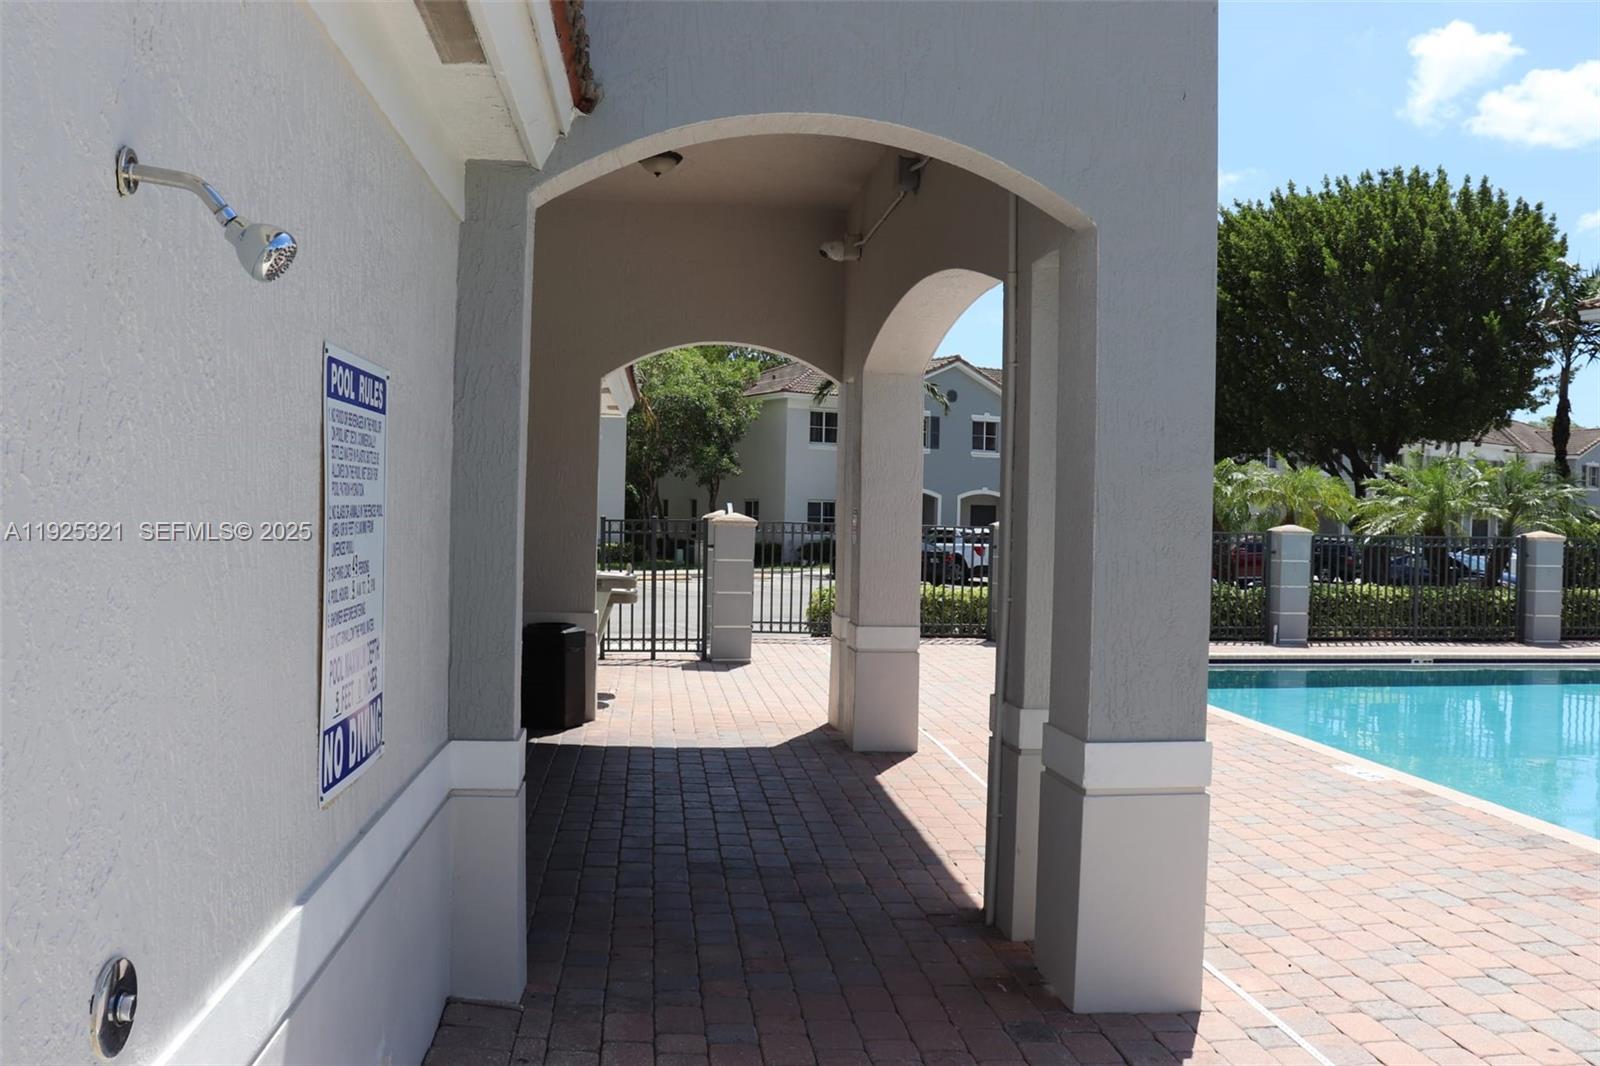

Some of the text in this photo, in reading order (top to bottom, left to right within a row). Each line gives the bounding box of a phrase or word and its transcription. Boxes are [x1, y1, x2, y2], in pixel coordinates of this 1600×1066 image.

[331, 363, 383, 409] POOL RULES
[323, 697, 382, 789] NO DIVING
